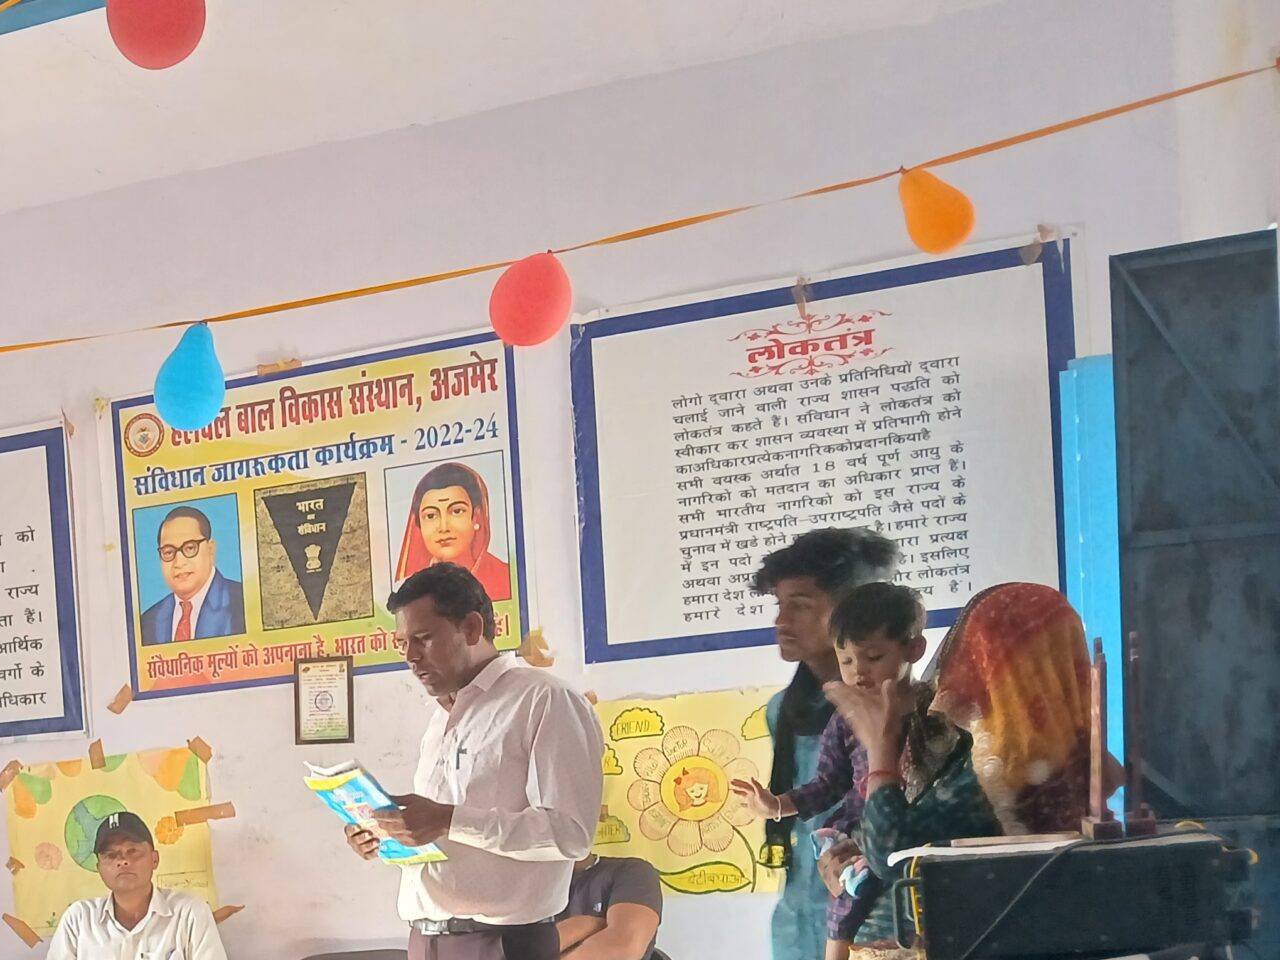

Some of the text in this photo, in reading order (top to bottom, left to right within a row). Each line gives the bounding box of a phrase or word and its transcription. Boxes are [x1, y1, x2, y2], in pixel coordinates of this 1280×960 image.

[746, 328, 875, 365] लोकतंत्र
[237, 400, 273, 436] बाल
[281, 385, 344, 428] विकास
[349, 370, 423, 414] संस्थान,
[430, 350, 498, 402] अजमेर
[672, 356, 960, 409] लोगो द्वारा अथवा उनके प्रतिनिधियों द्वारा
[673, 376, 930, 424] चलाई जाने वाली राज्य शासन पद्धति
[674, 395, 933, 442] लोकतंत्र कहते संविधान ने लोकतंत्र
[674, 406, 962, 458] स्वीकार कर शासन व्यवस्था प्रतिभागी होने
[133, 412, 499, 496] संविधान जागरूकता कार्यक्रम 2022-24
[712, 446, 940, 486] वयस्क अर्थात वर्ष पूर्ण आयु
[716, 481, 940, 518] भारतीय इस राज्य
[765, 464, 941, 496] मतदान अधिकार प्राप्त
[296, 498, 324, 512] भारत
[679, 495, 946, 540] प्रधानमंत्री जैसे पदों
[16, 526, 35, 542] को
[297, 522, 326, 535] संविधान
[680, 543, 716, 560] चुनाव
[764, 532, 786, 546] होने
[895, 514, 929, 531] हमारे
[933, 512, 968, 526] राज्य
[682, 547, 970, 589] अथवा इसलिए
[701, 530, 969, 572] इन प्रत्यक्ष
[4, 584, 39, 599] राज्य
[682, 593, 719, 606] हमारा
[723, 589, 744, 600] देश
[917, 564, 971, 579] लोकतंत्र
[24, 608, 42, 624] हैं।
[683, 606, 720, 622] हमारे
[30, 661, 45, 677] के
[147, 651, 203, 679] संवैधानिक
[207, 645, 240, 678] मूल्यों
[242, 643, 259, 667] को
[263, 642, 312, 666] अपनाना
[335, 635, 366, 656] भारत
[370, 627, 387, 651] को
[616, 720, 650, 736] FRIEND
